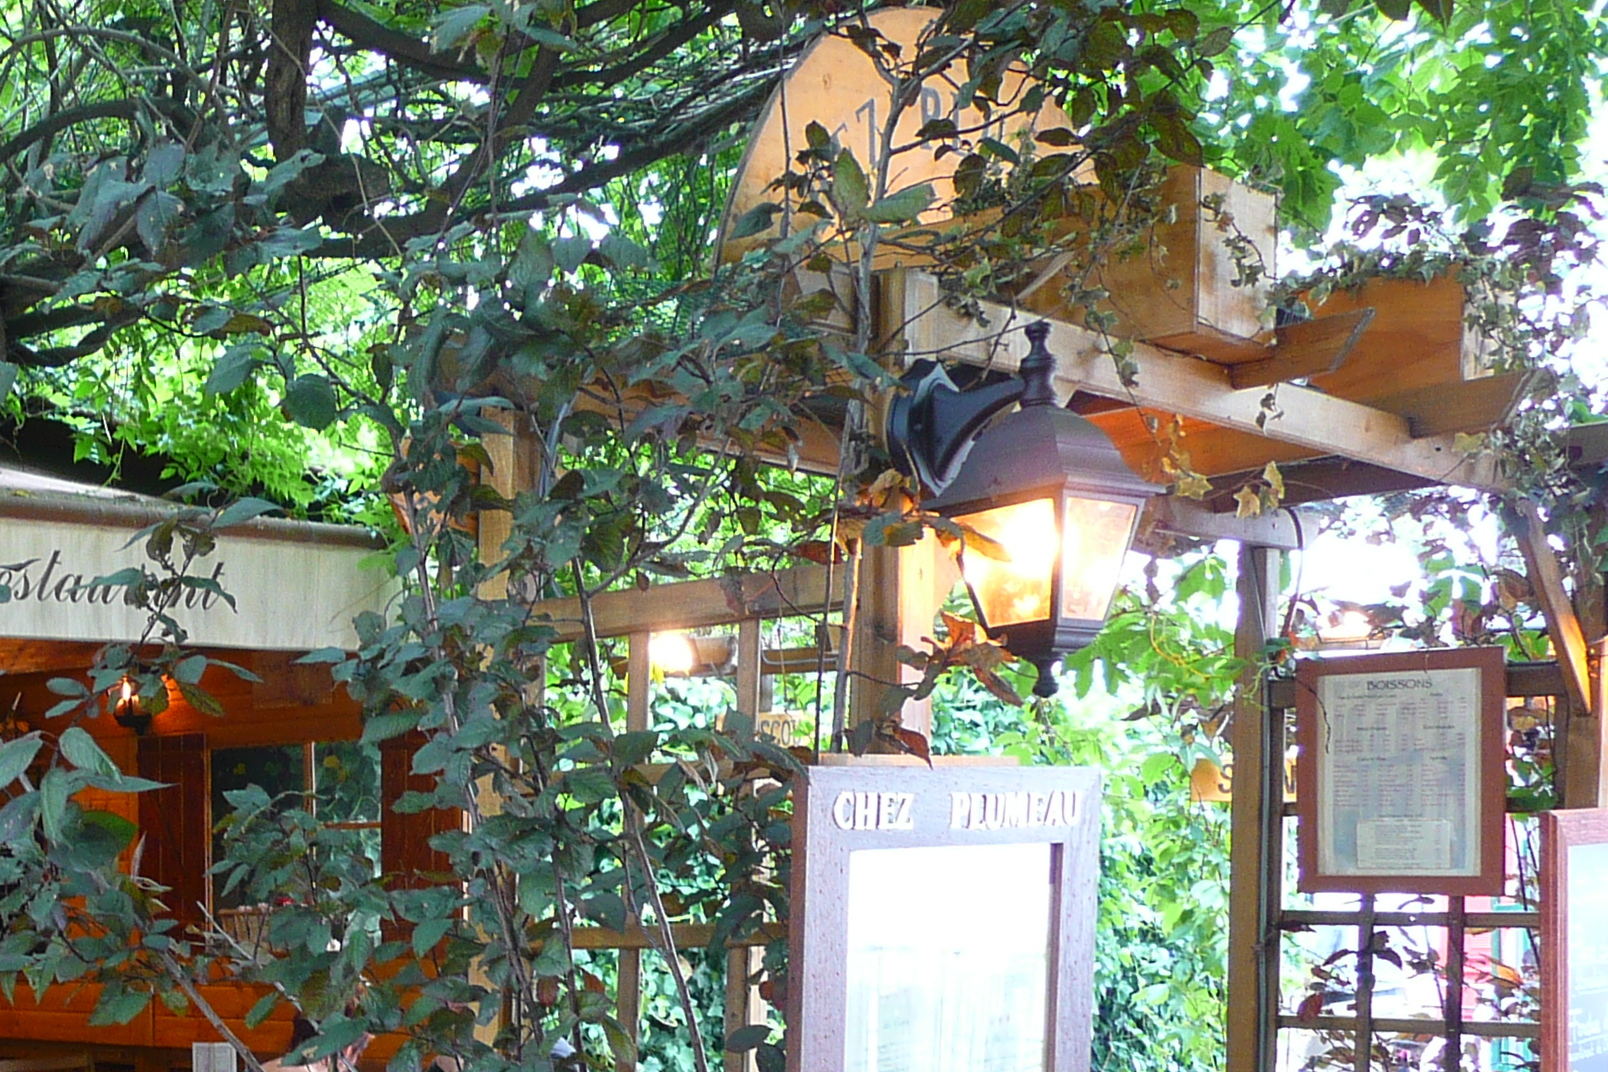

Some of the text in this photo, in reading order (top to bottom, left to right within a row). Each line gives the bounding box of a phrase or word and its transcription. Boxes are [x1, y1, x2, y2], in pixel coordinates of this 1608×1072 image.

[1367, 679, 1432, 690] BOISSONS
[834, 791, 1082, 830] CHEZ PLUMEAU
